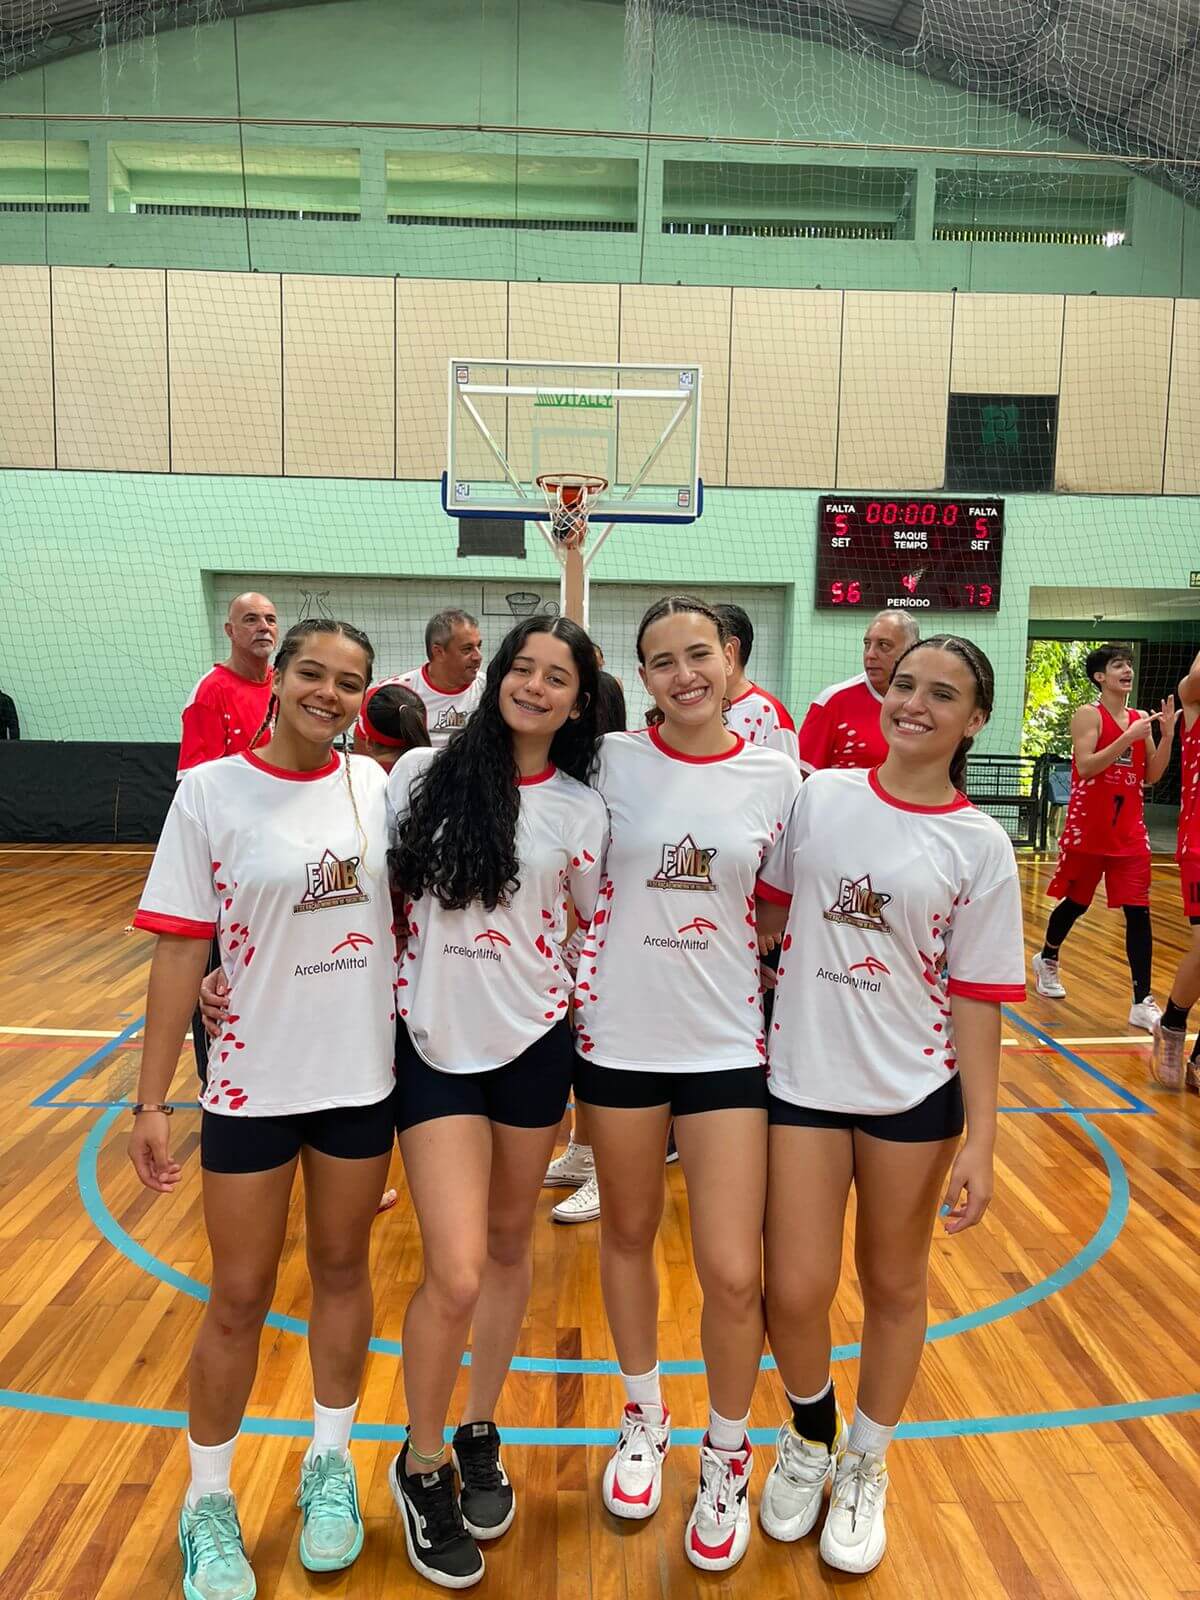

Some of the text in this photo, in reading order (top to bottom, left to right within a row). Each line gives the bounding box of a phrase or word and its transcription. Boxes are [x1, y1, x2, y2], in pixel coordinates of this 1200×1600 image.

[554, 393, 613, 408] VITALLY
[826, 504, 856, 513] FALTA
[968, 507, 998, 517] FALTA
[834, 514, 849, 536] 5
[975, 518, 989, 540] 5
[831, 537, 851, 548] SET
[893, 531, 928, 541] SAQUE
[893, 541, 928, 550] TEMPO
[970, 540, 990, 550] SET
[887, 597, 931, 608] PERÍODO
[661, 843, 711, 878] FMB
[305, 860, 358, 896] FMB
[643, 935, 709, 950] ArcelorMittal
[443, 944, 502, 962] ArcelorMittal
[294, 957, 368, 977] ArcelorMittal
